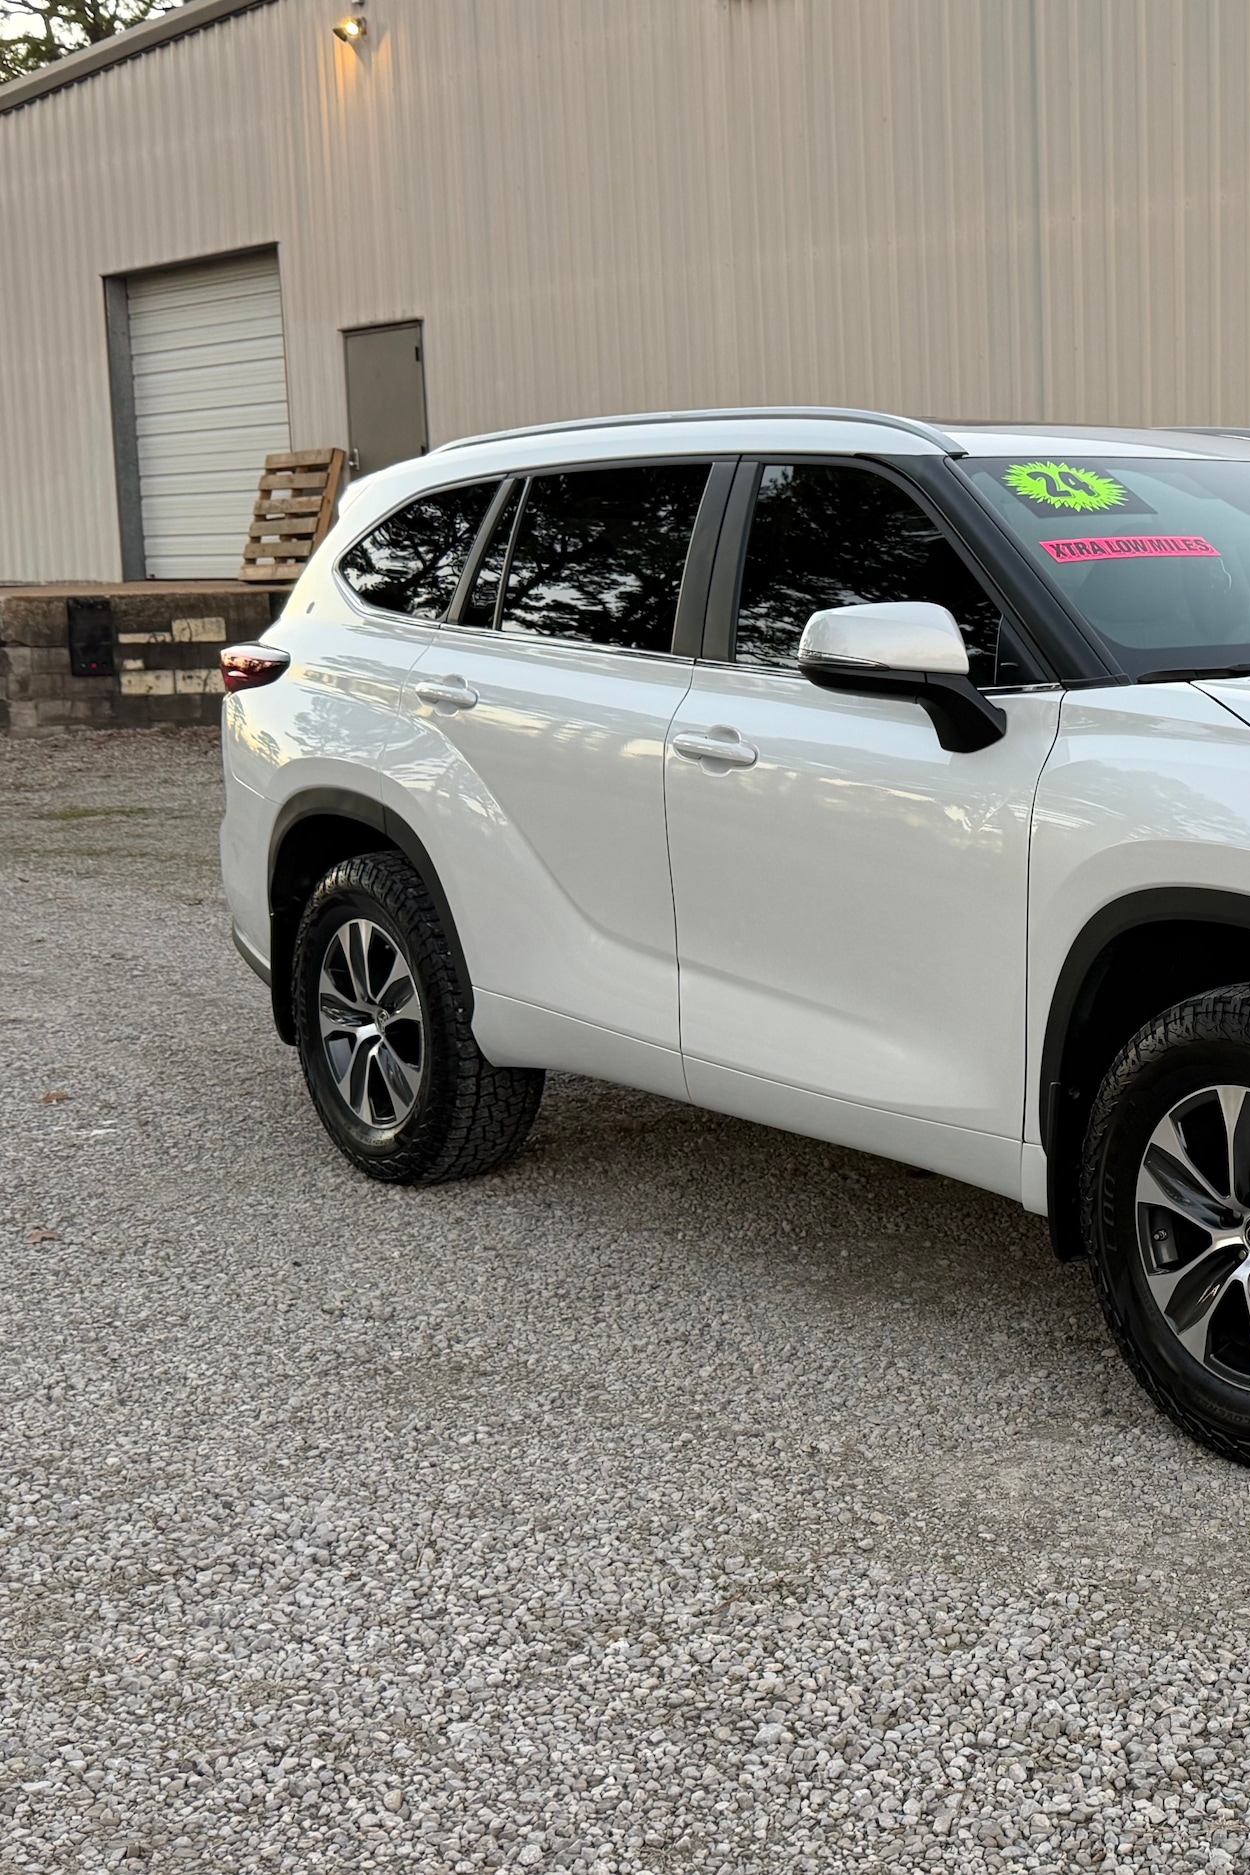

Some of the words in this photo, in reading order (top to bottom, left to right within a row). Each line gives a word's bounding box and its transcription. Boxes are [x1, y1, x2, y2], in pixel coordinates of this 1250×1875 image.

[1026, 471, 1100, 499] 24
[1049, 541, 1106, 558] XTRA
[1105, 539, 1148, 555] LOW
[1148, 538, 1212, 553] MILES
